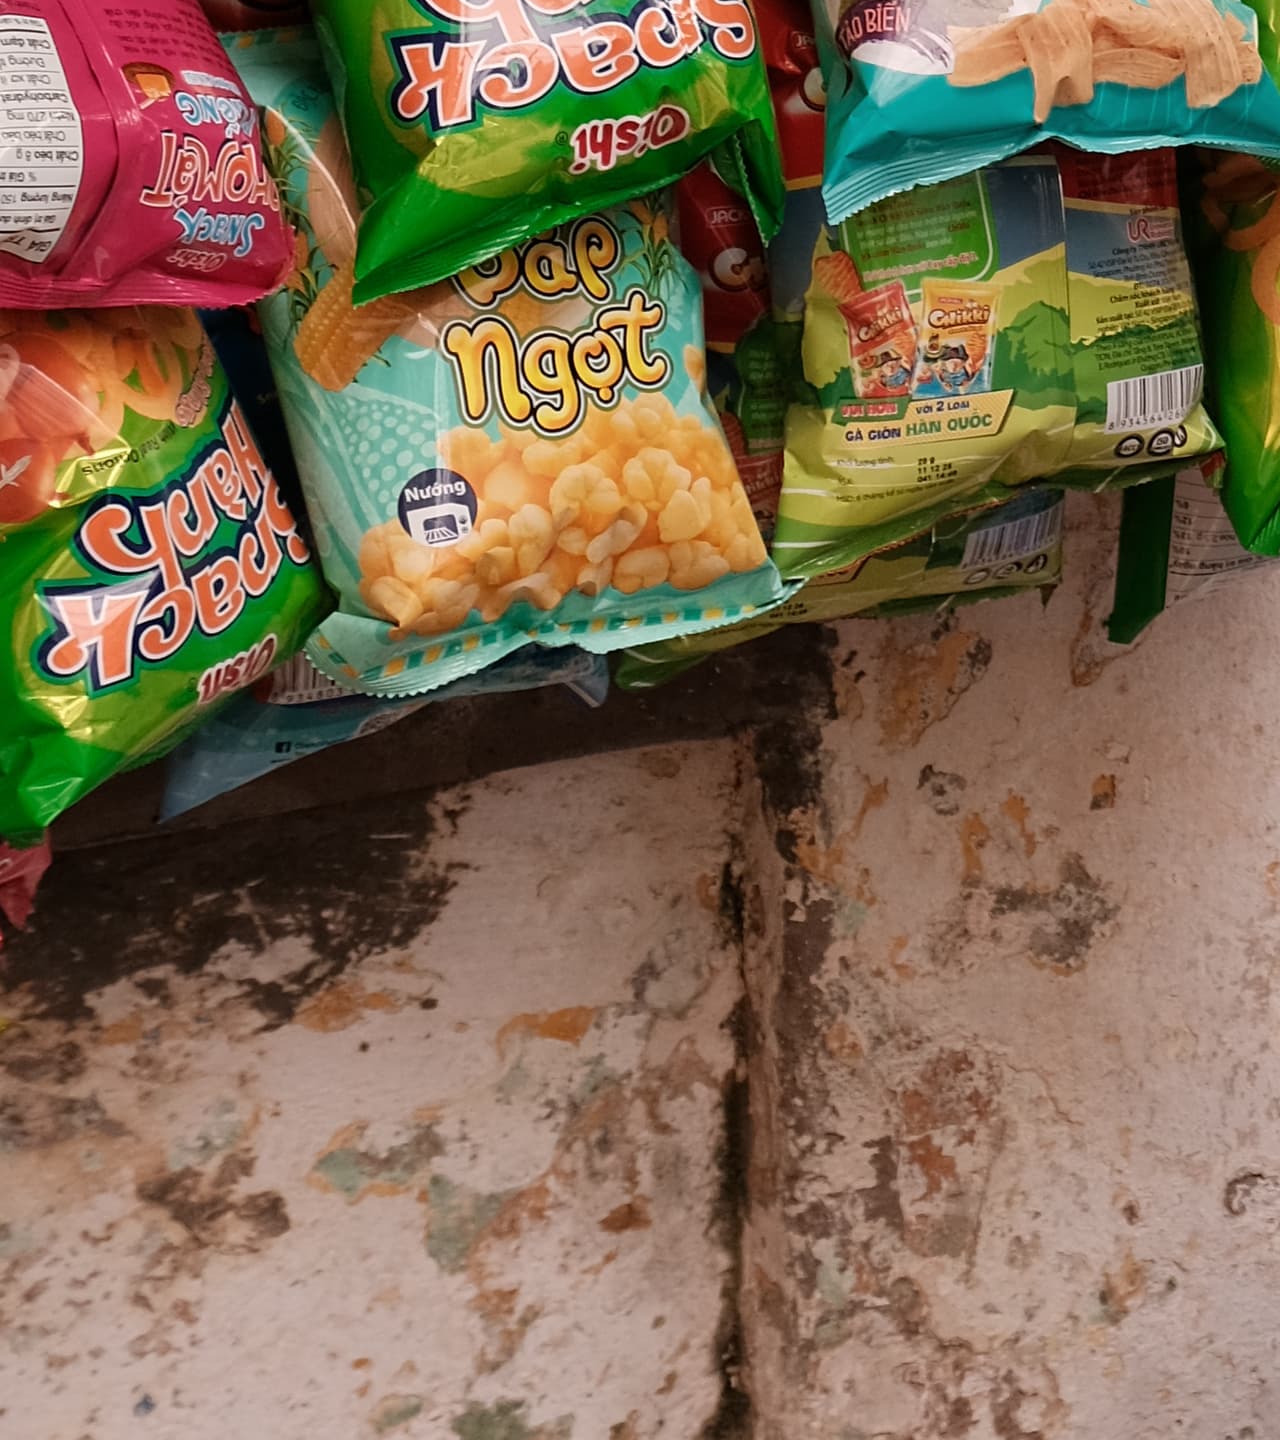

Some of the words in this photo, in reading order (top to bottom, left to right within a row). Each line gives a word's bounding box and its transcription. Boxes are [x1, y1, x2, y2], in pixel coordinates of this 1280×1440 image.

[568, 104, 690, 176] Oishi
[935, 400, 945, 413] 2
[844, 424, 865, 443] GÀ
[867, 423, 902, 442] GIÒN
[905, 417, 942, 439] HÀN
[946, 405, 993, 431] QUỐC
[404, 476, 468, 507] Nướng
